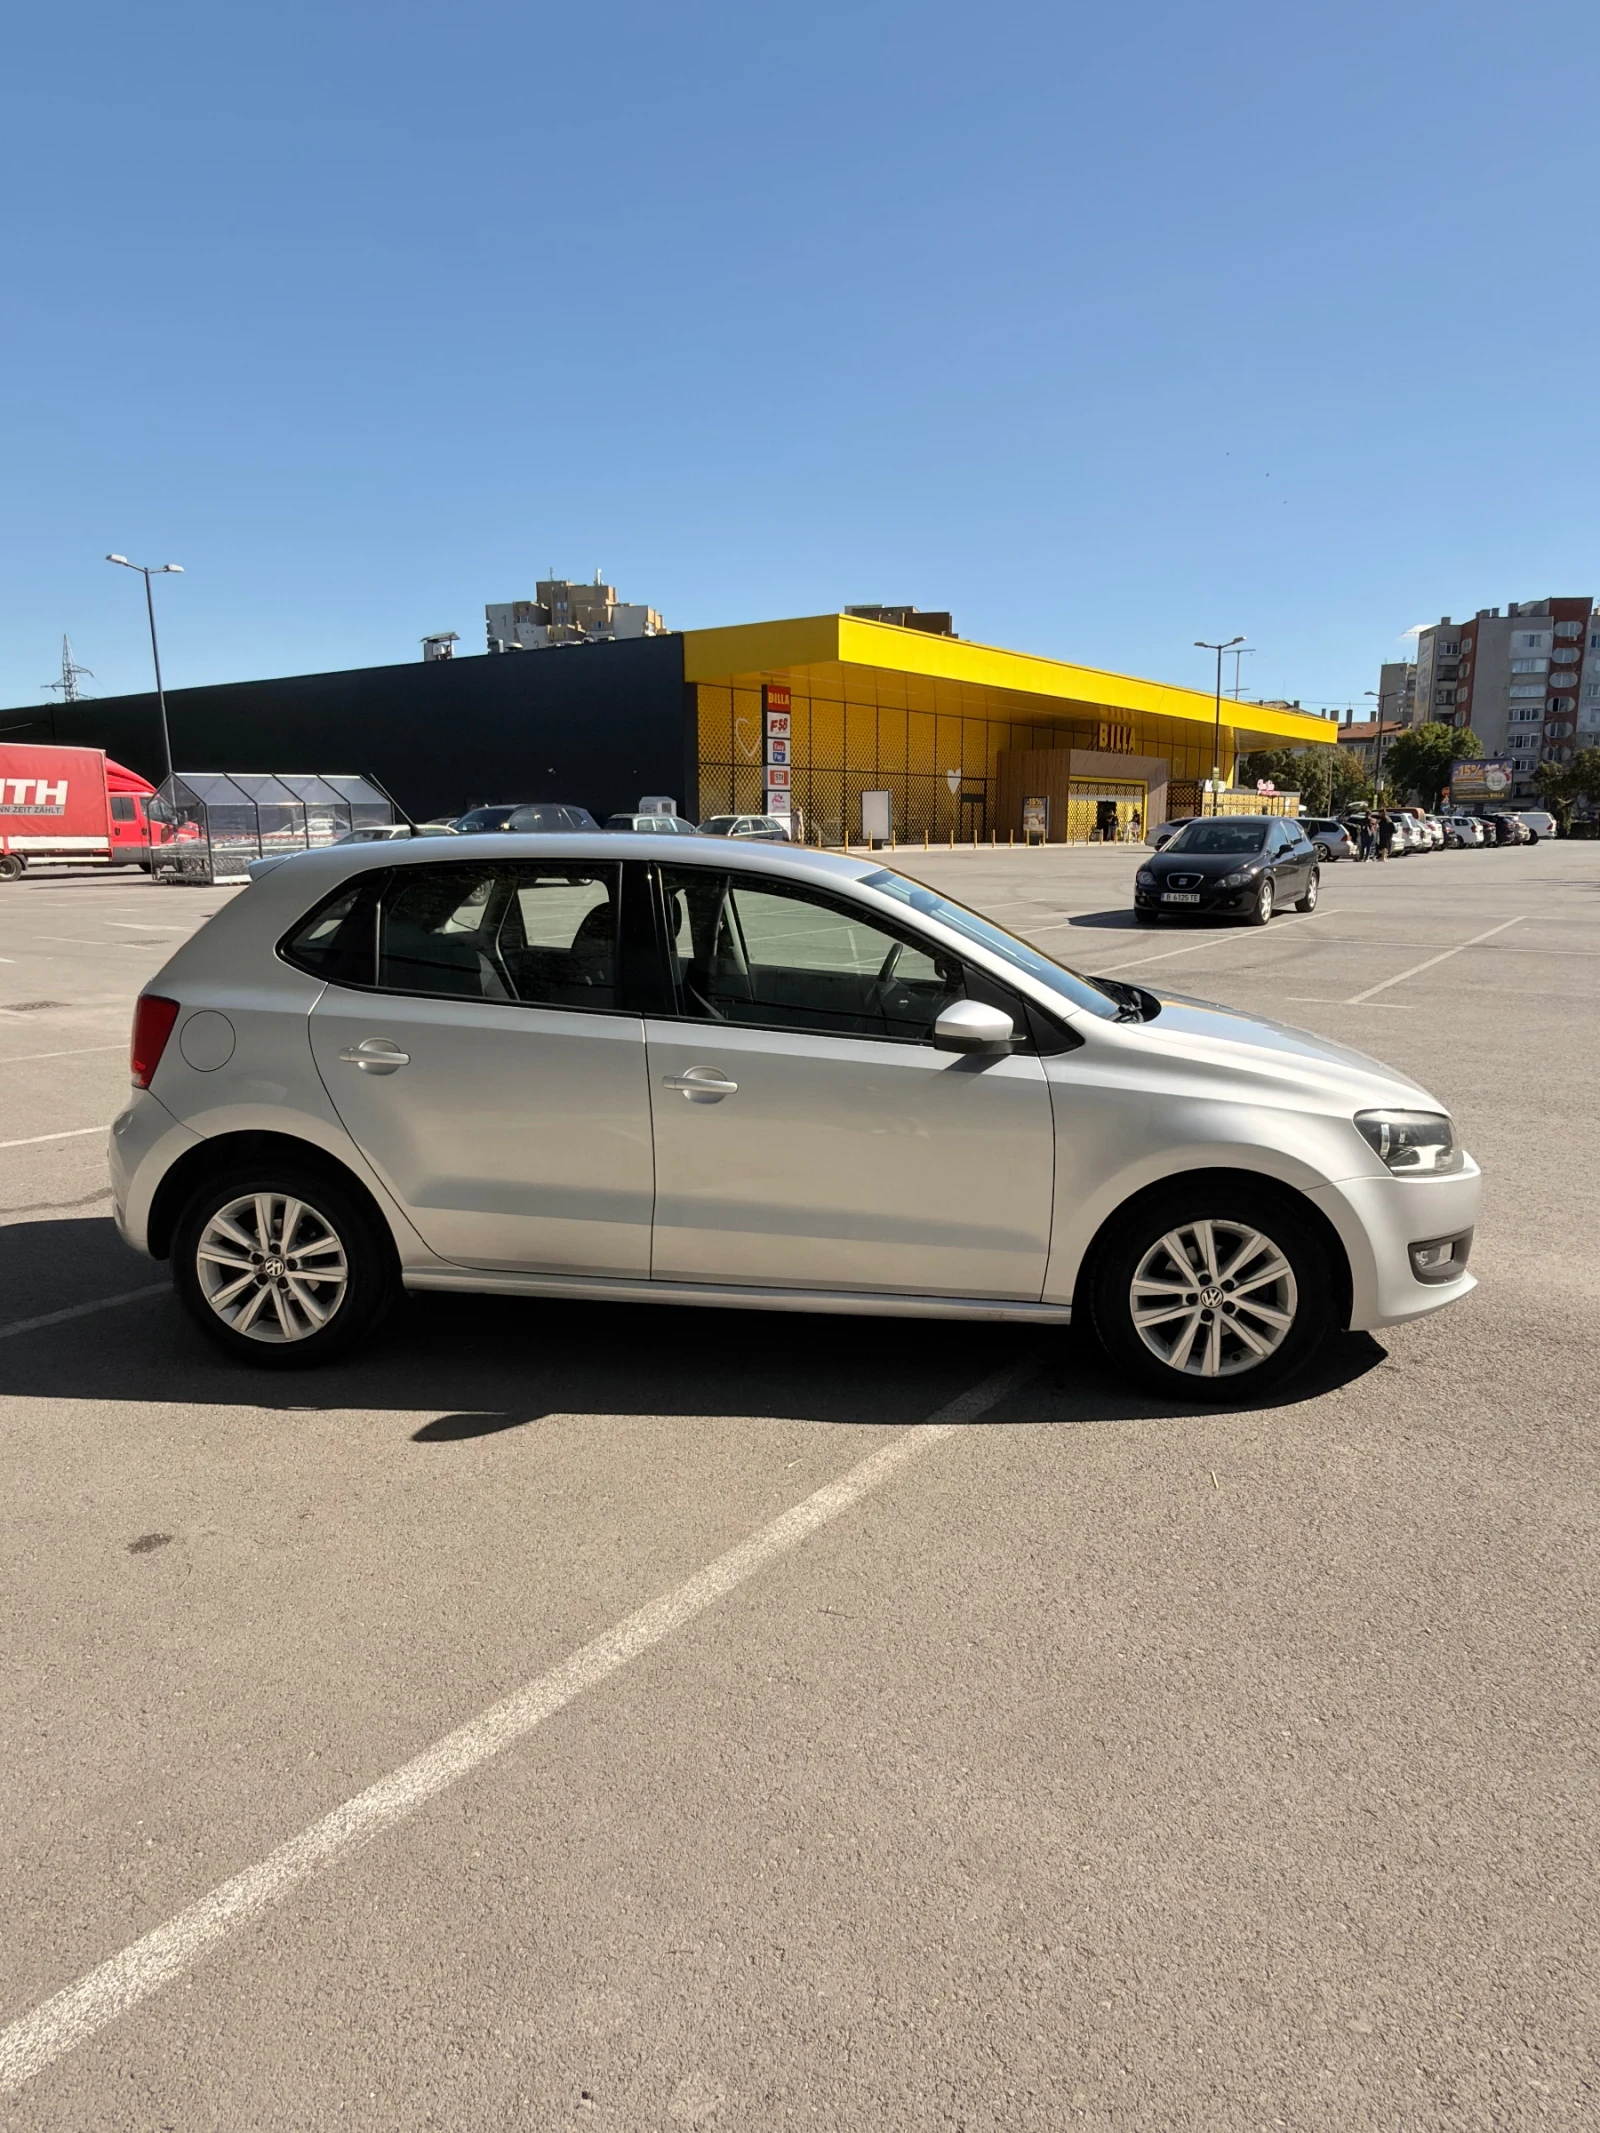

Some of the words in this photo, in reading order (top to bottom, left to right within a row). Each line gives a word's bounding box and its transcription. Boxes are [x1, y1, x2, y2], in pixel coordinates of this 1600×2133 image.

[768, 692, 790, 705] BILLA
[1098, 722, 1136, 751] BILLA
[13, 806, 32, 814] ZEIT
